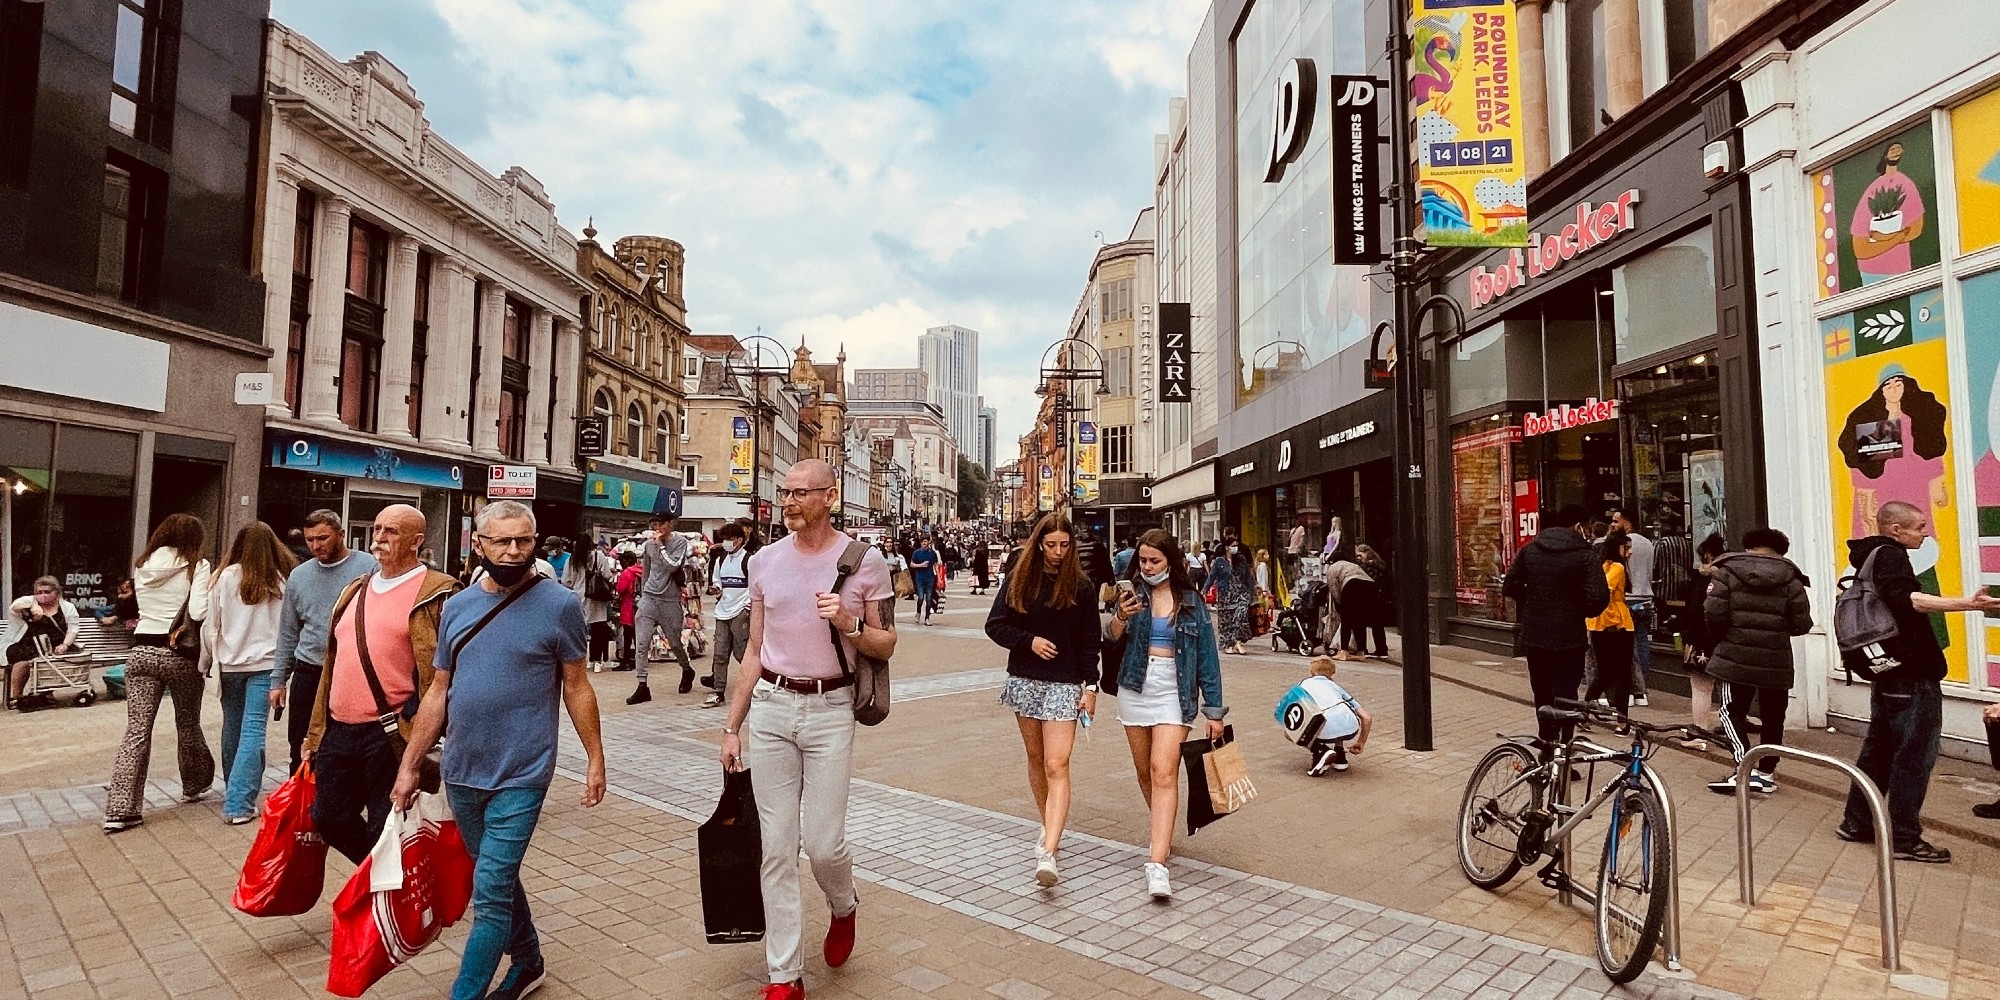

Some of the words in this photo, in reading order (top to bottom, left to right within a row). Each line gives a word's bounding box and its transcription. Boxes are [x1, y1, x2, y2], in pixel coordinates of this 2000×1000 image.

[1472, 12, 1490, 72] PARK,
[1337, 81, 1375, 106] JD
[1475, 76, 1493, 134] LEEDS
[1263, 58, 1306, 183] JD
[1351, 113, 1364, 181] TRAINERS
[1434, 149, 1451, 161] 14
[1461, 147, 1481, 160] 08
[1491, 146, 1507, 158] 21
[1353, 182, 1364, 196] OF
[1353, 197, 1365, 231] KING
[1164, 333, 1187, 397] ZARA
[243, 382, 263, 391] M&S
[1326, 433, 1340, 447] KING
[1345, 420, 1375, 441] TRAINERS
[1277, 439, 1292, 472] JD
[1410, 464, 1420, 473] 34
[69, 597, 108, 609] MMER
[76, 587, 91, 596] ON
[1287, 705, 1302, 730] JD
